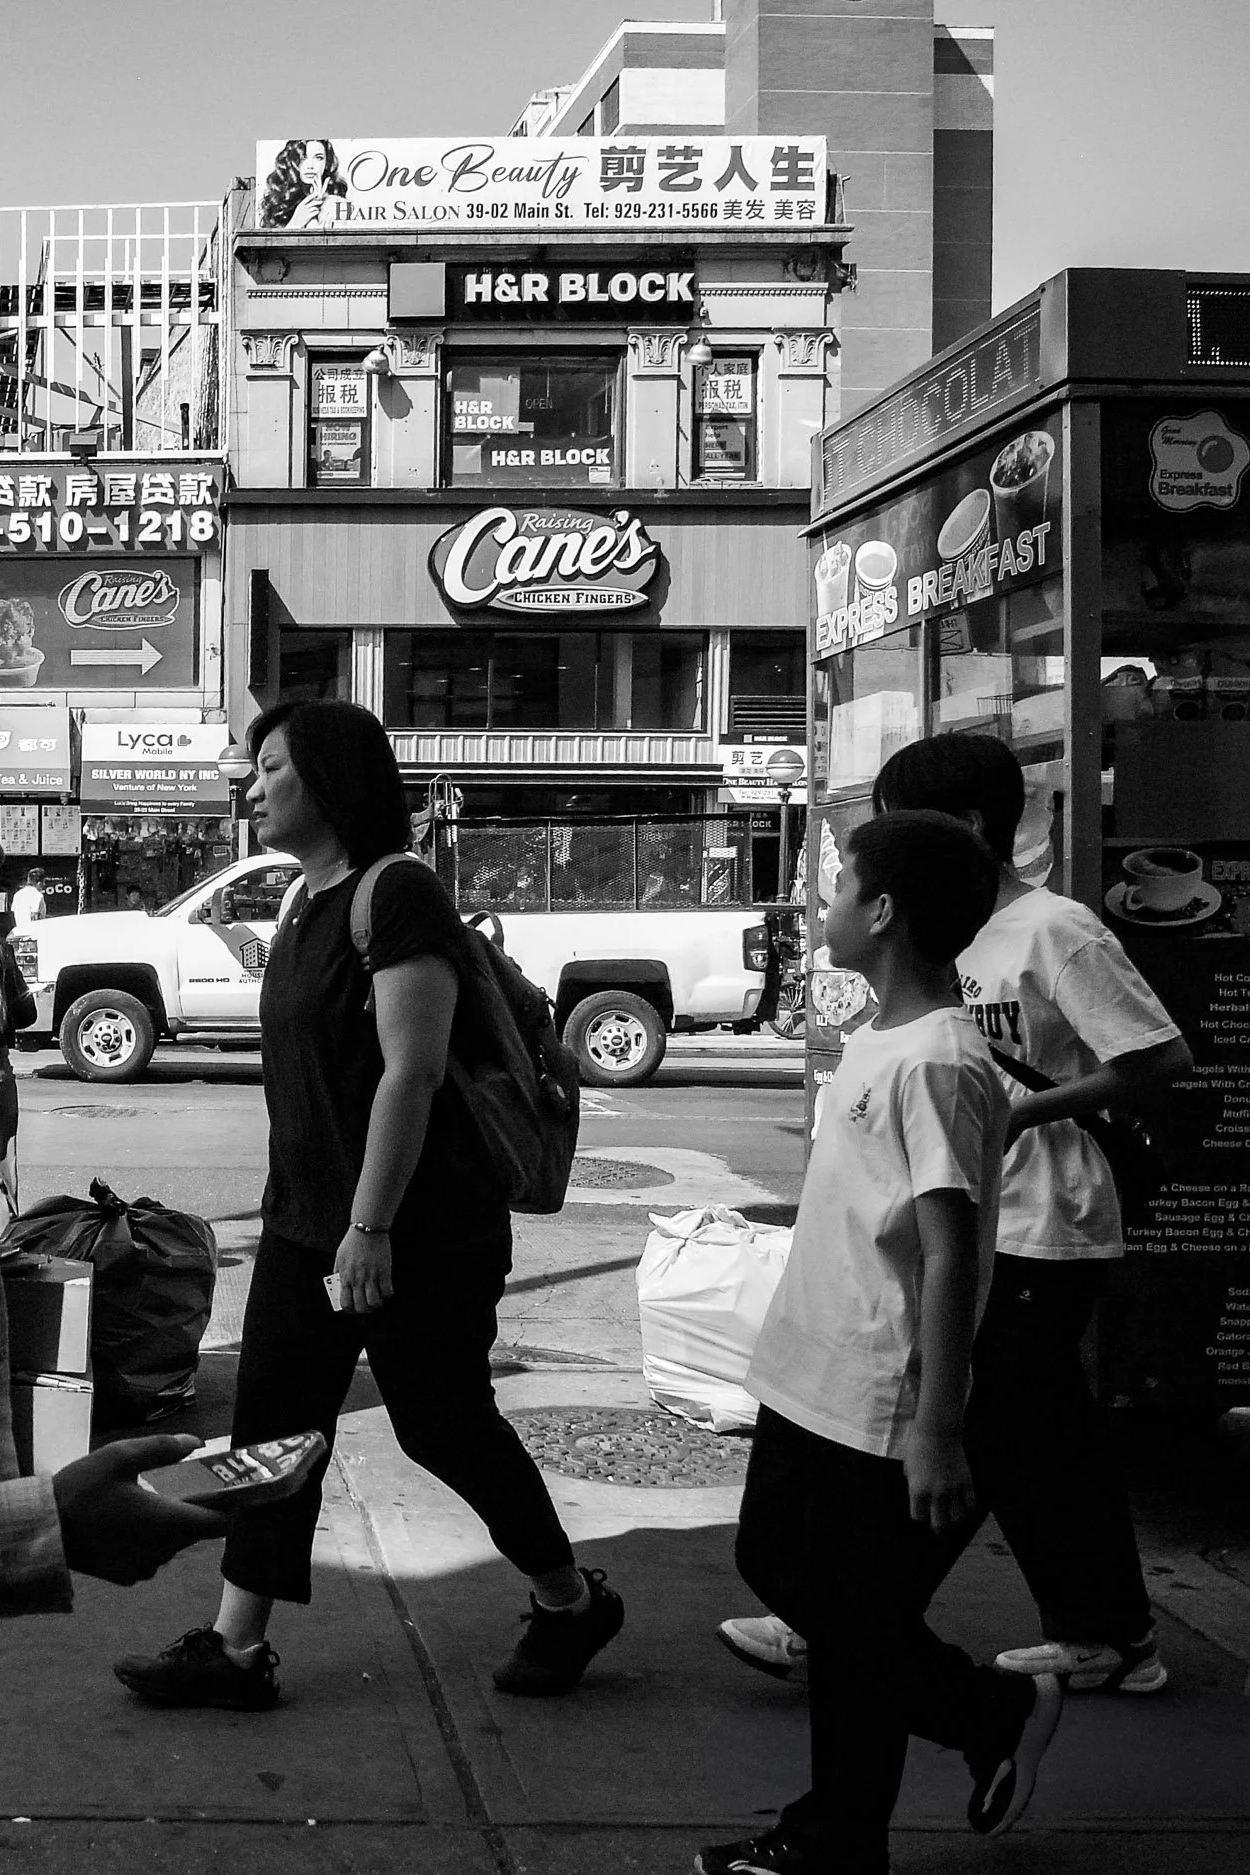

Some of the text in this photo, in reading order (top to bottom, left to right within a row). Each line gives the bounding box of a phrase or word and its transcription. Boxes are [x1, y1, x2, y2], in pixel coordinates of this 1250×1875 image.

[347, 144, 589, 199] One Beauty
[599, 145, 816, 193] 剪艺人生
[466, 203, 508, 219] 39-02
[514, 203, 549, 219] Main
[555, 203, 573, 219] St.
[584, 203, 609, 219] Tel:
[614, 202, 718, 219] 929-231-5566
[774, 199, 816, 220] 美容
[465, 272, 695, 304] H&R BLOCK
[314, 367, 365, 380] 公司成立
[697, 363, 748, 376] 个人家庭
[319, 384, 359, 404] 报税
[701, 380, 742, 399] 报税
[454, 400, 493, 414] H&R
[454, 415, 515, 430] BLOCK
[491, 448, 611, 466] H&R BLOCK
[1160, 469, 1203, 481] Express
[65, 472, 214, 506] 房屋贷款
[1158, 482, 1233, 497] Breakfast
[520, 512, 594, 534] Raising
[443, 507, 657, 604] Cane's
[907, 521, 1051, 616] BREAKFAST
[65, 572, 176, 624] Cane's
[514, 592, 633, 604] CHICKEN FINGERS
[816, 586, 898, 652] EXPRESS
[118, 731, 173, 750] Lyca
[18, 773, 29, 785] &
[31, 773, 64, 785] Juice
[91, 769, 220, 780] SILVER WORLD NY INC
[113, 783, 198, 792] Venture of New York
[41, 884, 73, 895] oCo
[1214, 973, 1233, 982] Hot
[1219, 987, 1238, 997] Hot
[1210, 1003, 1250, 1012] Herbal
[1200, 1020, 1219, 1029] Hot
[1213, 1034, 1236, 1044] Iced
[1227, 1064, 1250, 1073] With
[1211, 1080, 1235, 1088] With
[1202, 1139, 1243, 1148] Cheese
[1170, 1183, 1210, 1193] Cheese
[1213, 1184, 1227, 1193] on
[1144, 1198, 1250, 1210] urkey Bacon Egg &
[1155, 1212, 1201, 1223] Sausage
[1204, 1213, 1225, 1224] Egg
[1228, 1213, 1235, 1222] &
[1126, 1227, 1162, 1238] Turkey
[1165, 1227, 1200, 1237] Bacon
[1202, 1227, 1224, 1239] Egg
[1226, 1227, 1235, 1237] &
[1146, 1242, 1168, 1253] Egg
[1170, 1242, 1178, 1252] &
[1181, 1242, 1221, 1252] Cheese
[1223, 1244, 1238, 1252] on
[1206, 1346, 1245, 1358] Orange
[1218, 1361, 1239, 1370] Red
